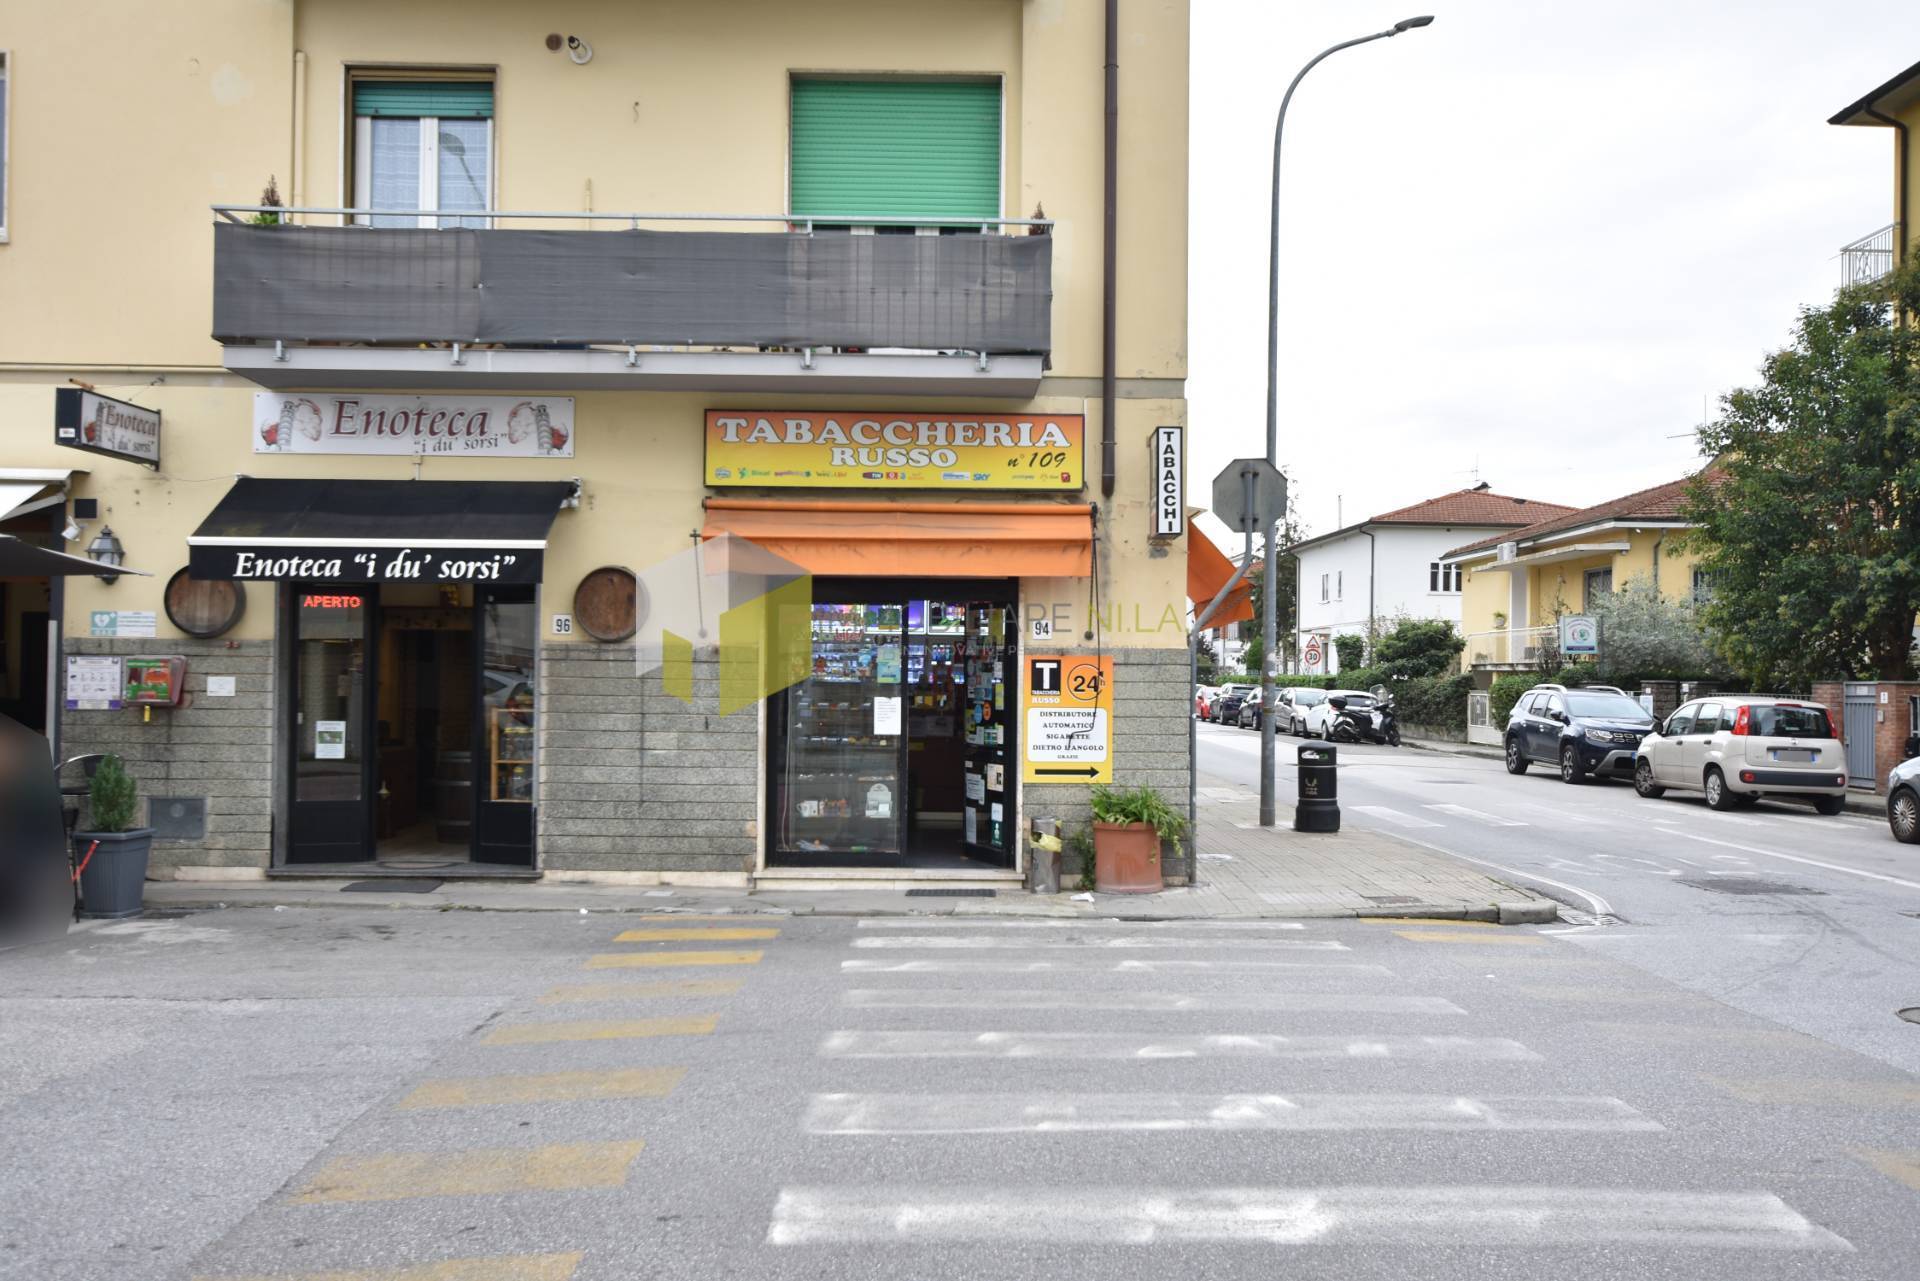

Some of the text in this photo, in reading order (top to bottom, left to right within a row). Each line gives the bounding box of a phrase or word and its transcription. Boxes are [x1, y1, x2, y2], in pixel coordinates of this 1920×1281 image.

[106, 405, 157, 436] Enoteca
[330, 400, 491, 437] Enoteca
[716, 418, 1072, 447] TABACCHERIA
[831, 447, 958, 468] RUSSO
[1029, 452, 1066, 468] 109
[1163, 431, 1177, 532] TABACCHI
[233, 552, 342, 578] Enoteca
[304, 595, 361, 609] APERTO
[556, 618, 570, 632] 96
[1034, 621, 1050, 636] 94
[1308, 652, 1318, 661] 30
[1035, 662, 1058, 689] T
